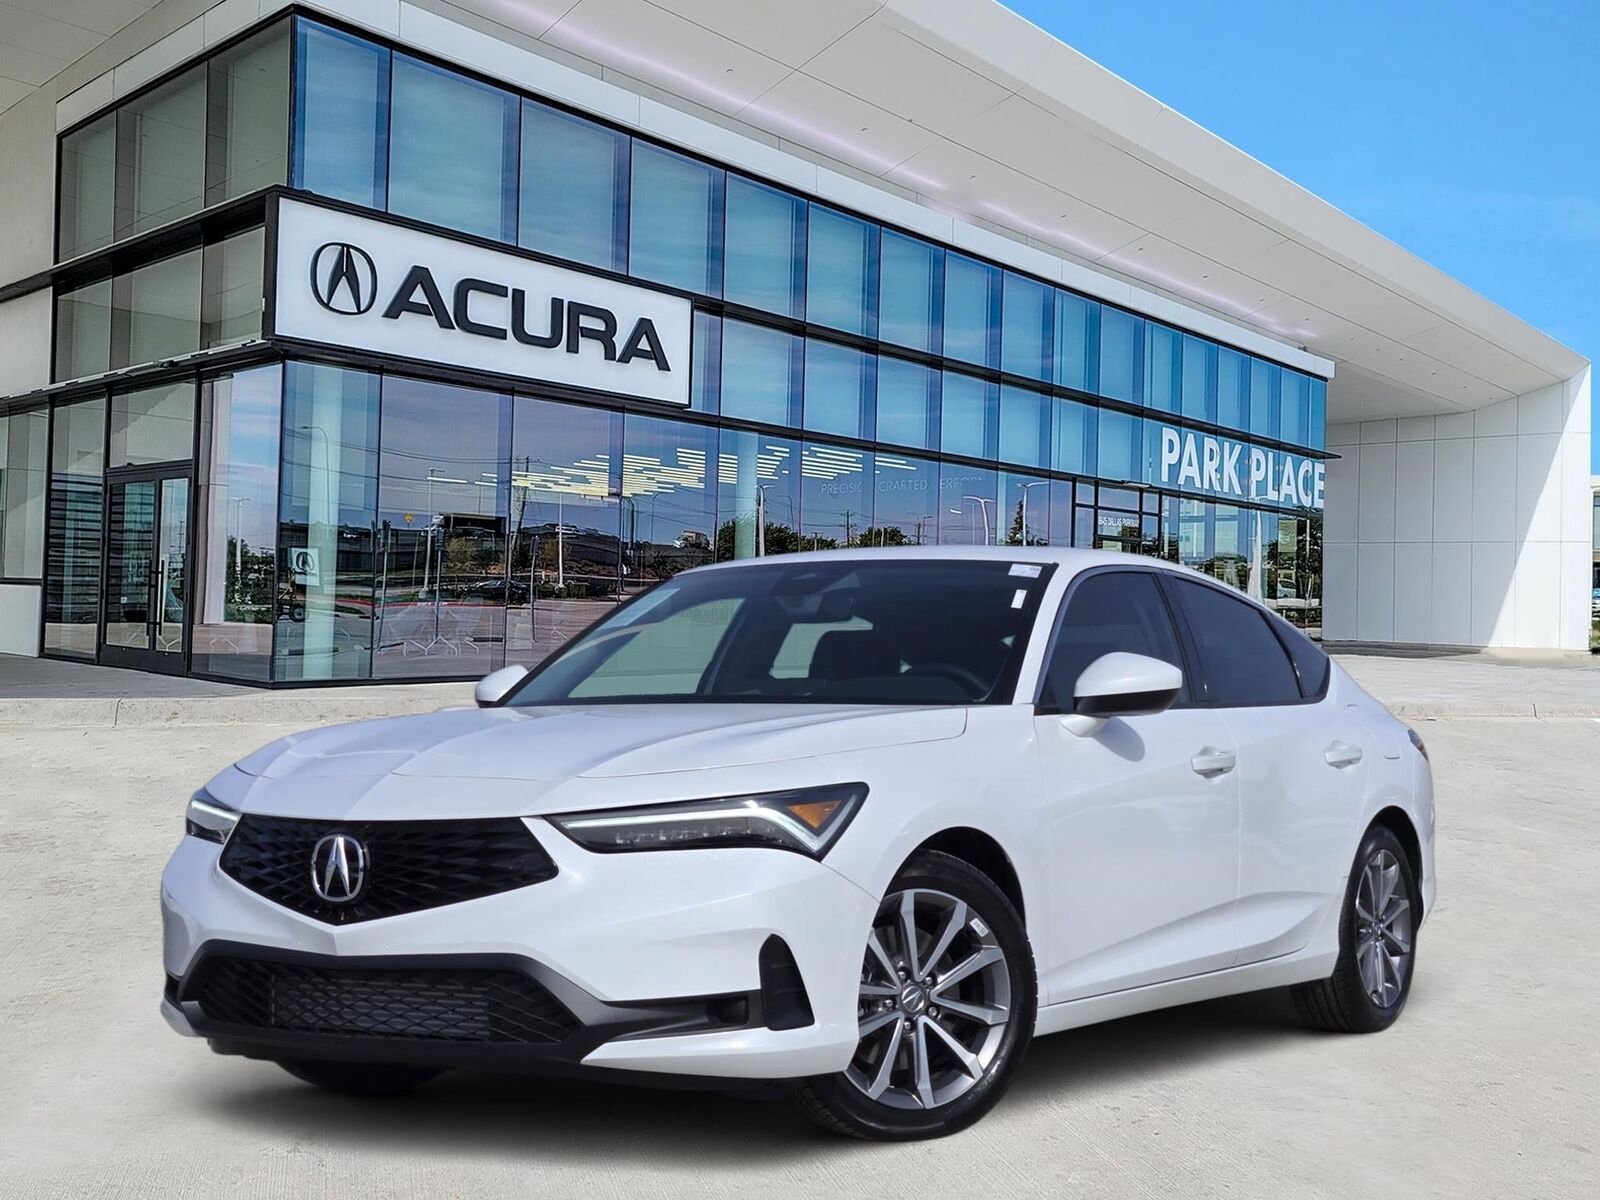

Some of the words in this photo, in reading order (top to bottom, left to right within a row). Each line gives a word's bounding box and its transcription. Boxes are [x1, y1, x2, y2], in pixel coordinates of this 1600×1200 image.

[382, 265, 671, 372] ACURA
[879, 478, 928, 493] CRAFTED
[1161, 427, 1242, 495] PARK
[1251, 447, 1325, 507] PLACE
